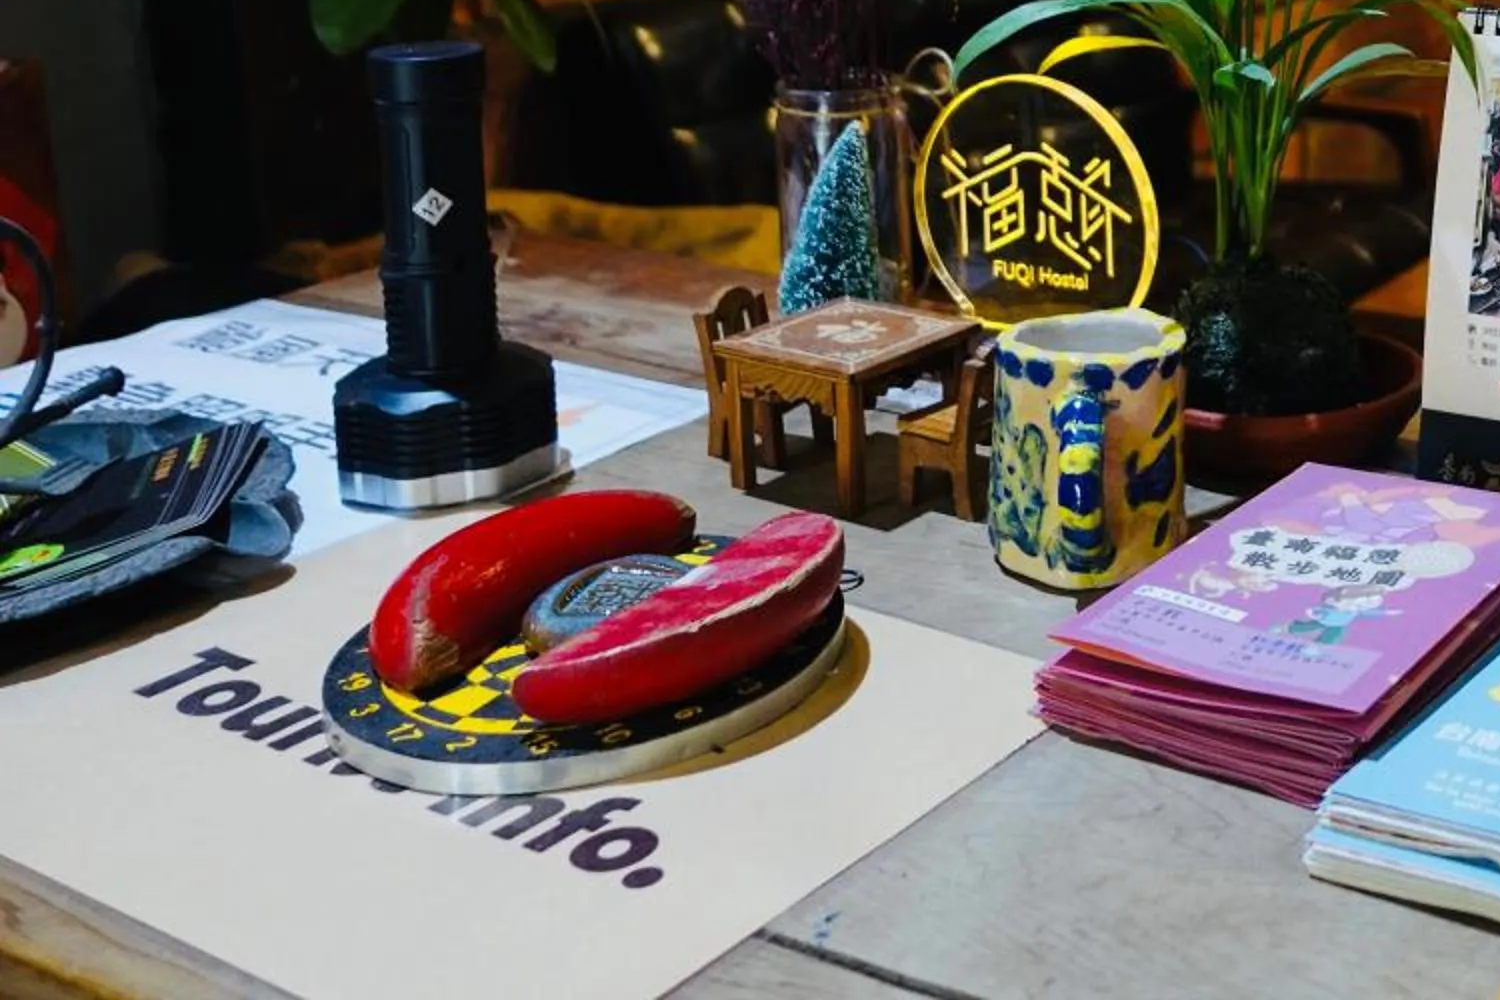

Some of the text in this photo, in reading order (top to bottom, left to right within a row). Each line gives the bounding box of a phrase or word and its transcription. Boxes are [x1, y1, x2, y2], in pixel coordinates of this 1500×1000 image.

[992, 259, 1089, 291] FUQI Hostel
[385, 721, 426, 745] 17
